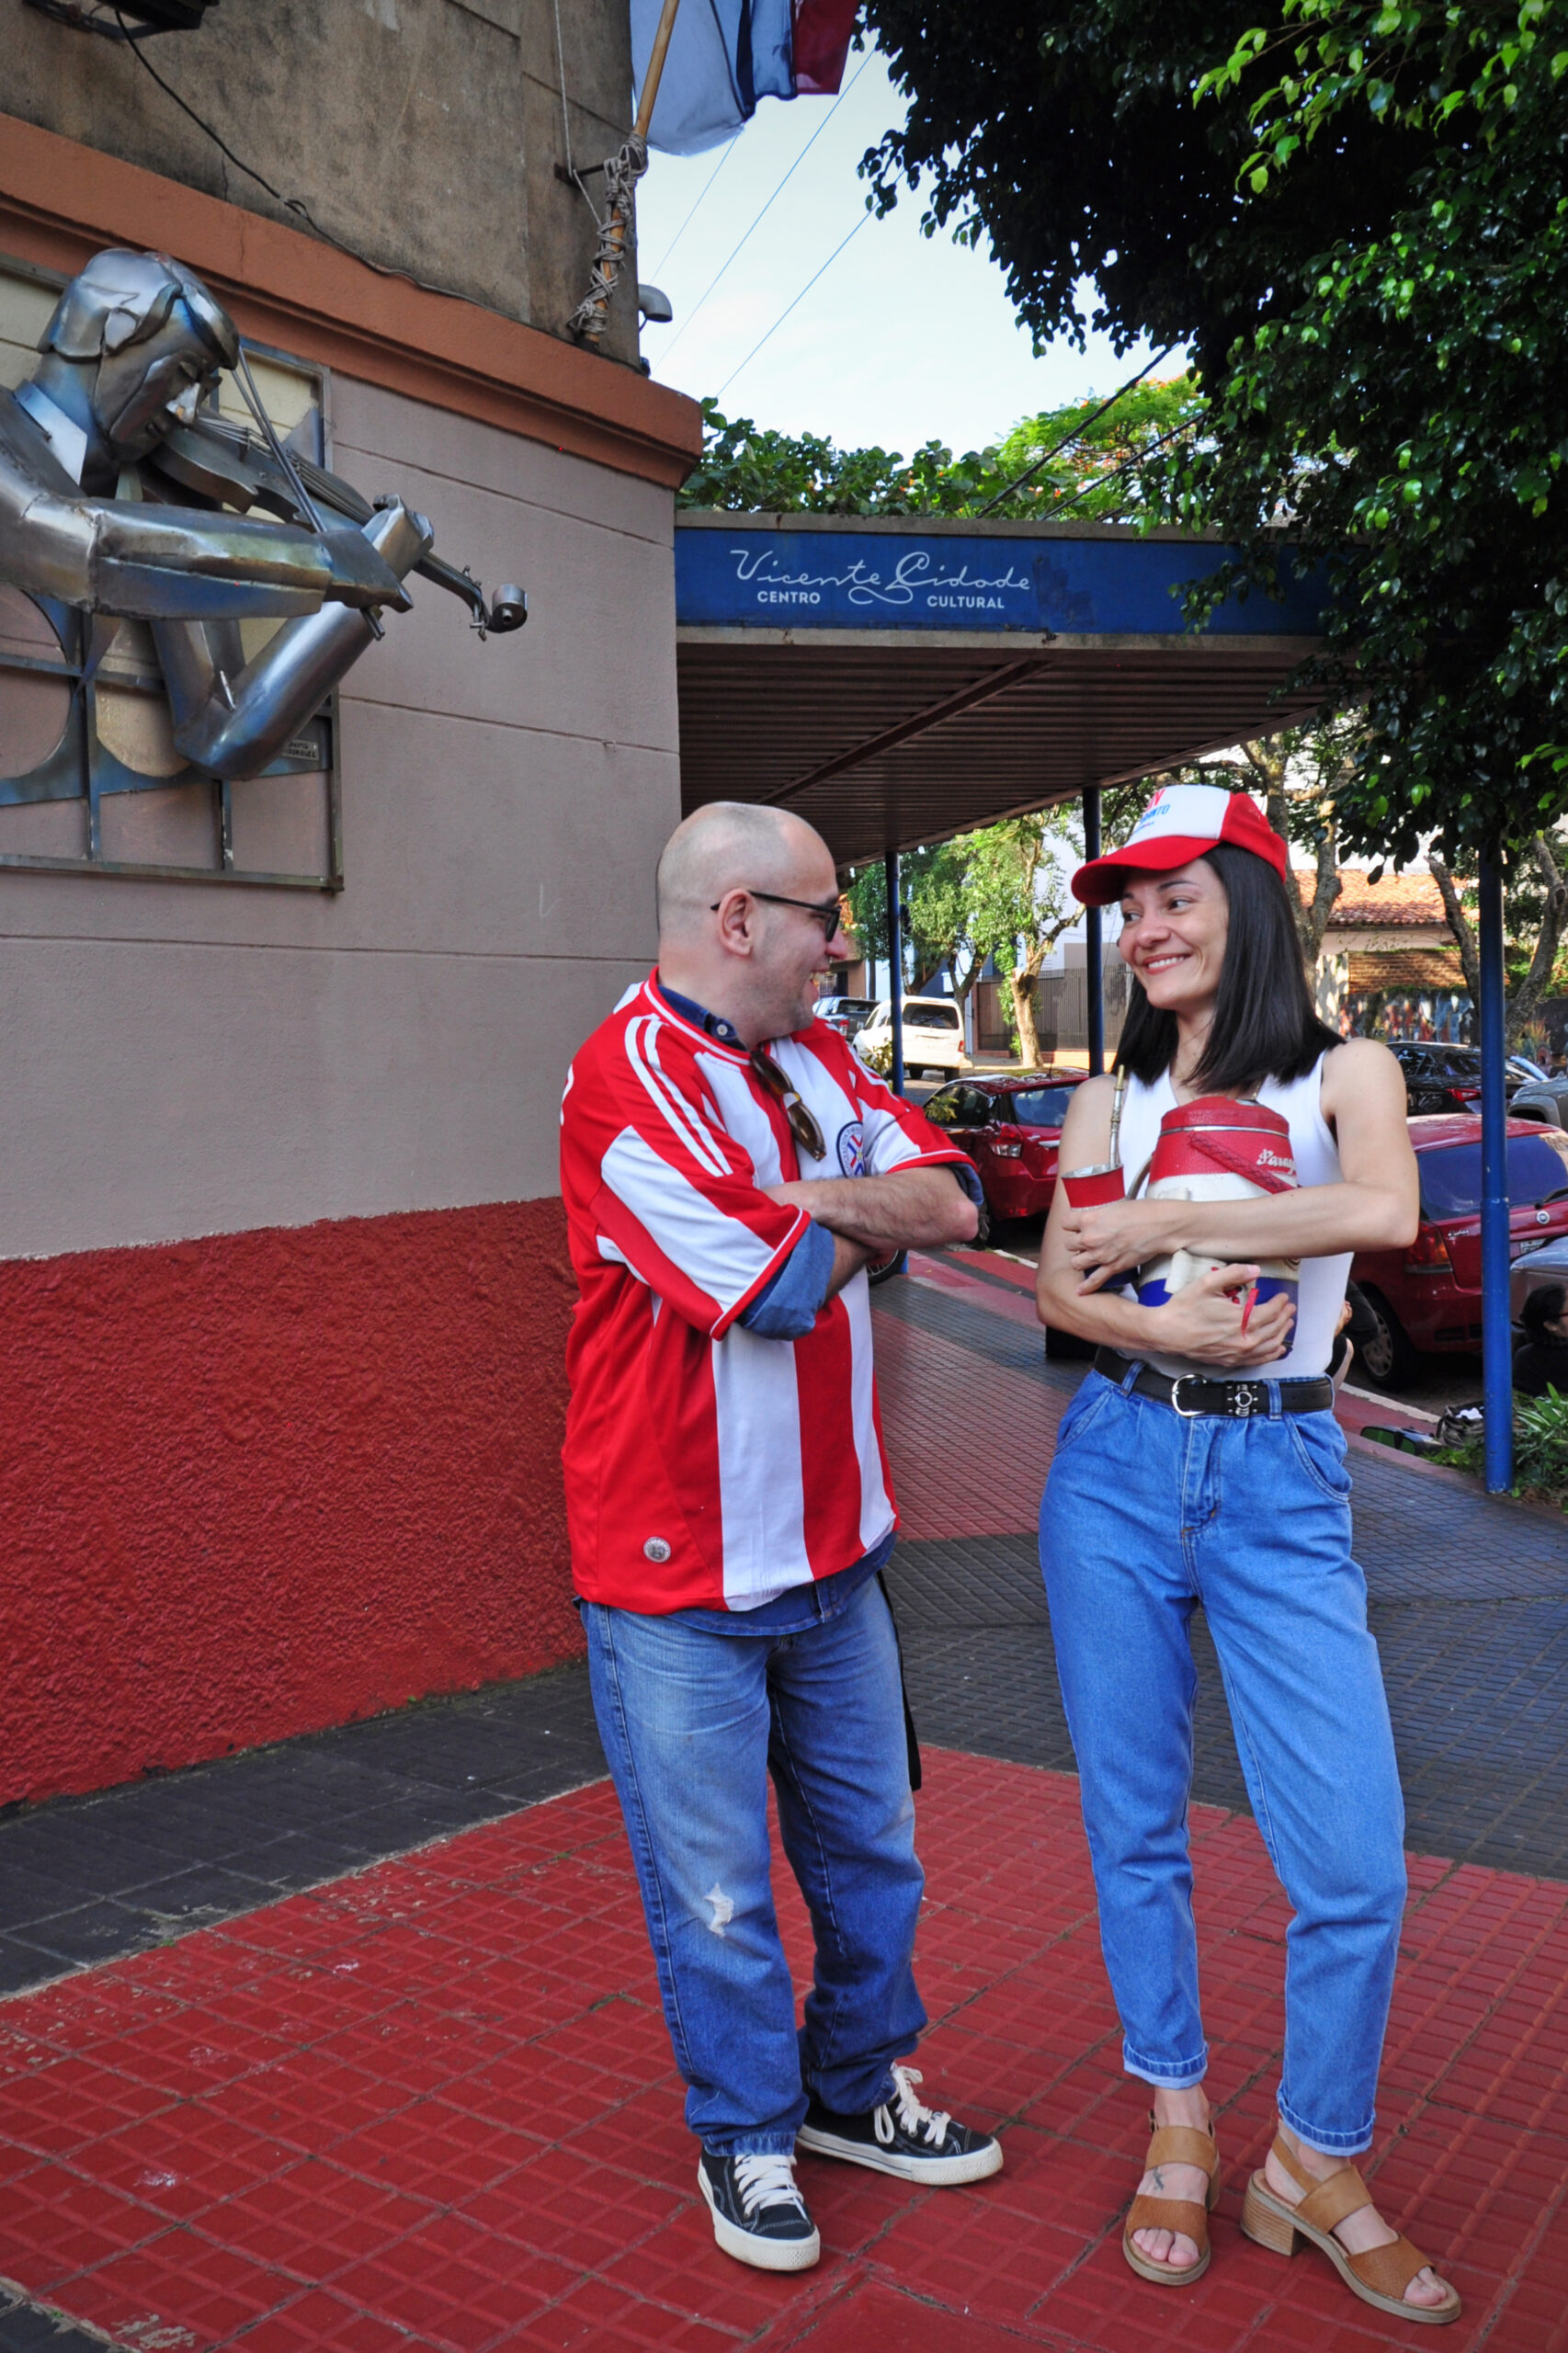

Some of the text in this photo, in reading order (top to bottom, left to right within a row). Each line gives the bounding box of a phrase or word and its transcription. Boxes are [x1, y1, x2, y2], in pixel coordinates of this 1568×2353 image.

[729, 550, 881, 586] Vicente
[756, 590, 1006, 608] CENTRO CULTURAL
